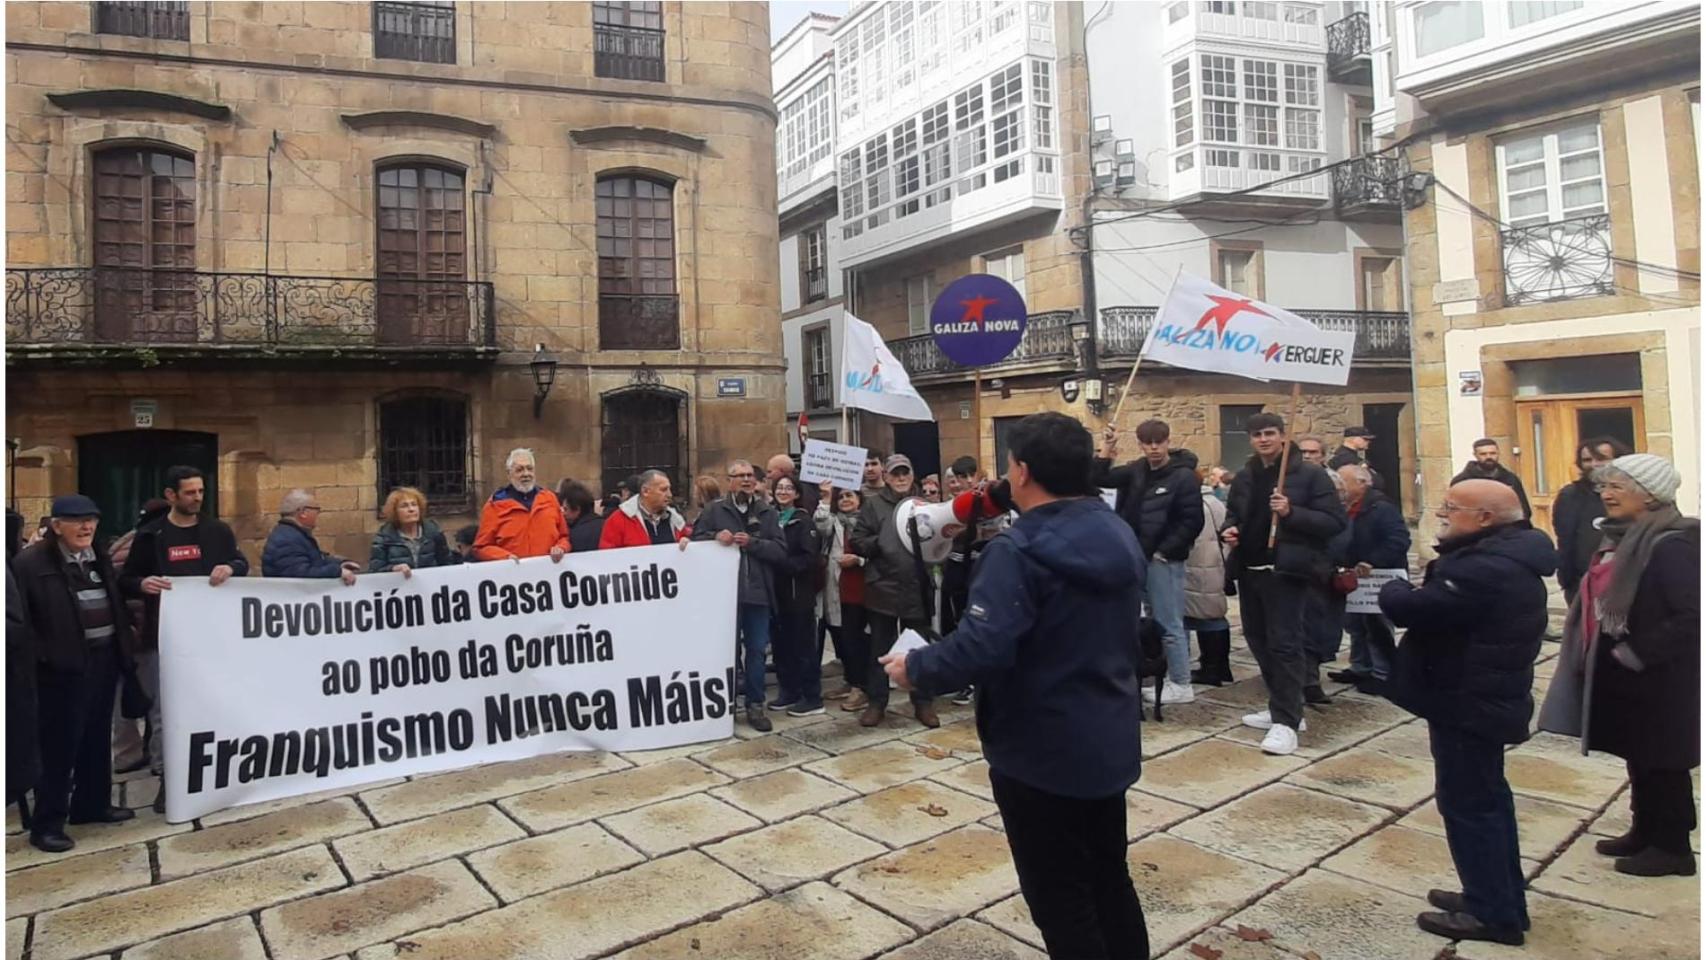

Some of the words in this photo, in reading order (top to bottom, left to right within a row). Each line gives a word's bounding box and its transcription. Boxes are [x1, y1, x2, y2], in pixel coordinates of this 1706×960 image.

[934, 321, 979, 334] GALIZA
[984, 319, 1019, 332] NOVA
[1155, 323, 1213, 350] ALIZA
[1285, 344, 1345, 366] ERGUER
[171, 548, 189, 557] New
[241, 588, 425, 638] Devolución
[431, 585, 471, 624] da
[478, 579, 553, 619] Casa
[559, 563, 679, 609] Cornide
[322, 659, 361, 696] ao
[370, 646, 451, 695] pobo
[458, 639, 499, 680] da
[505, 624, 614, 674] Coruña
[187, 708, 474, 794] Franquismo
[484, 688, 618, 745] Nunca
[627, 667, 735, 728] Máis!
